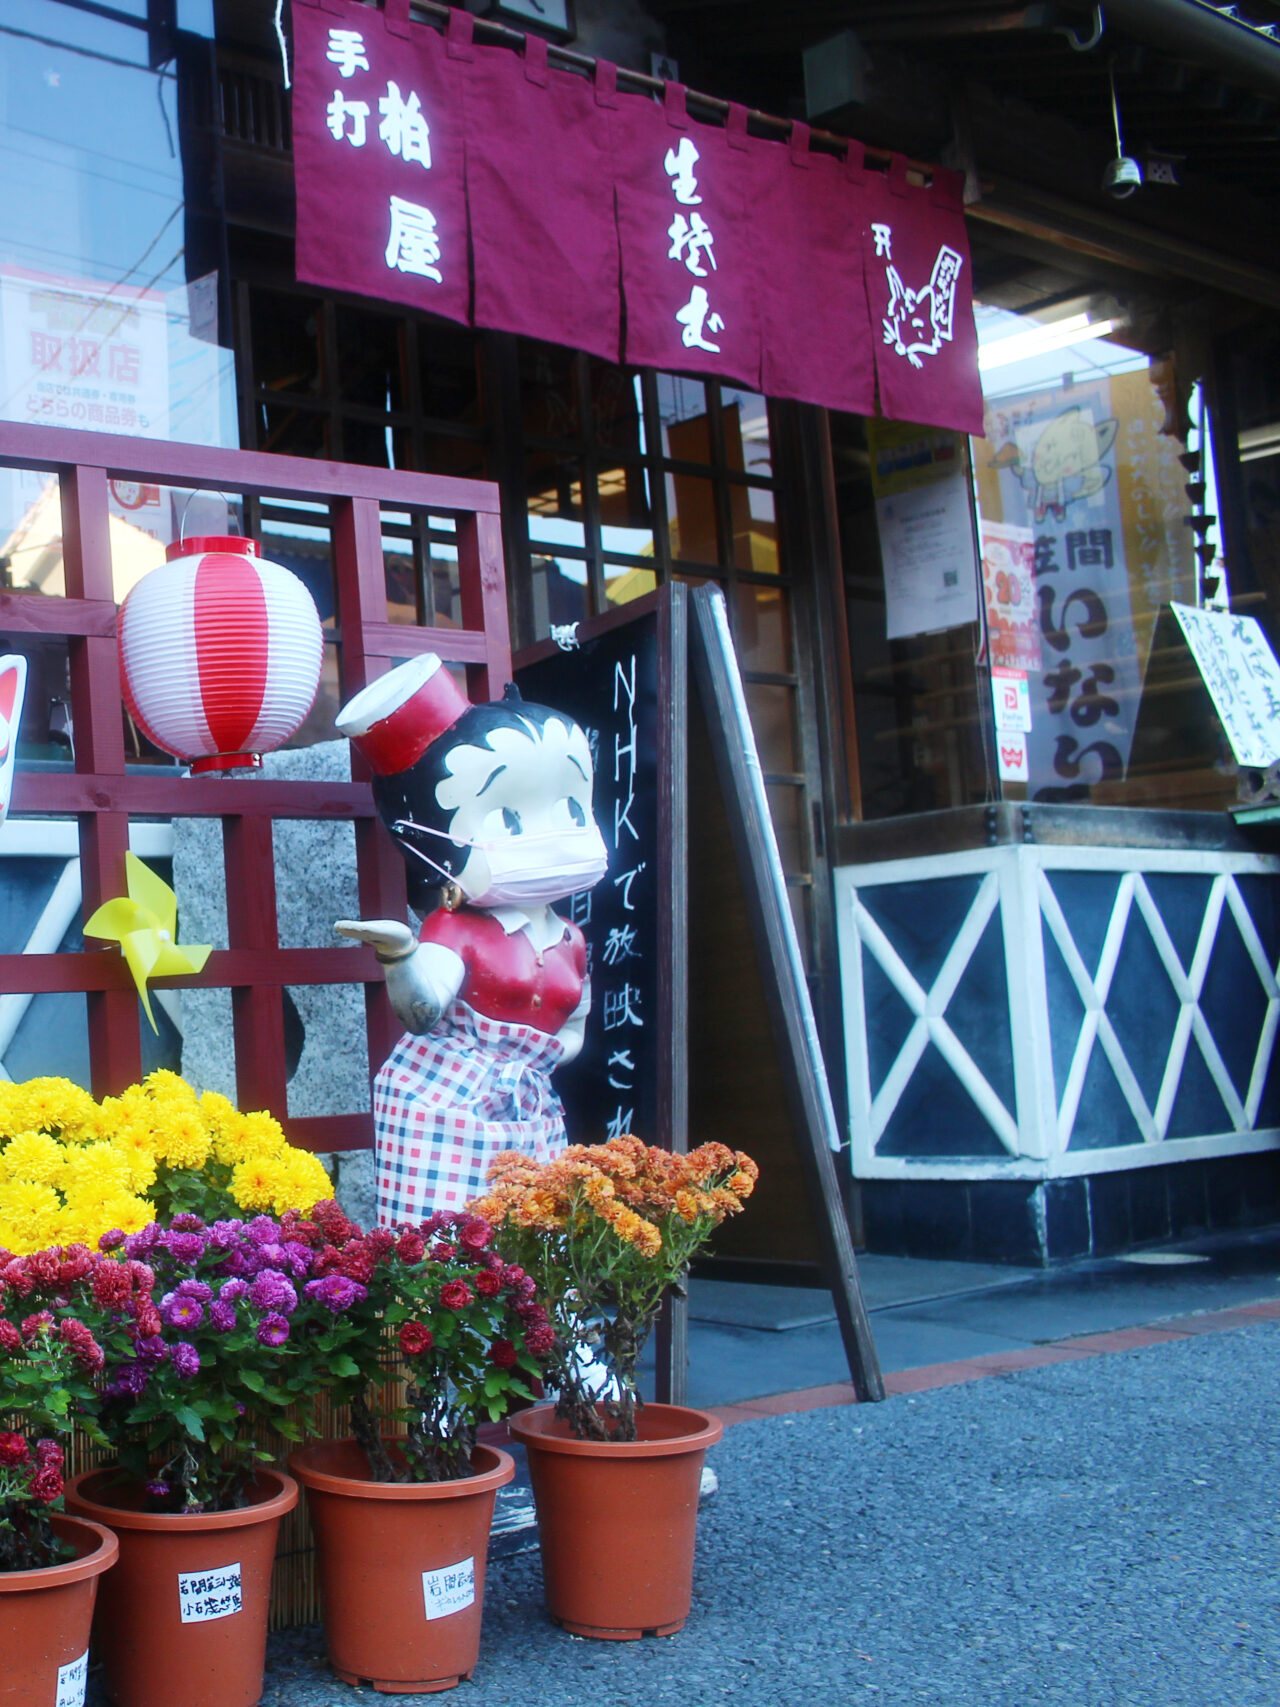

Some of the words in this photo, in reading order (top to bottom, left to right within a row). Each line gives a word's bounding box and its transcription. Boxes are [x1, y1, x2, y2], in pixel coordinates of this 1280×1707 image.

[326, 28, 371, 148] 手打
[377, 79, 444, 284] 柏屋
[30, 330, 140, 385] 取扱店
